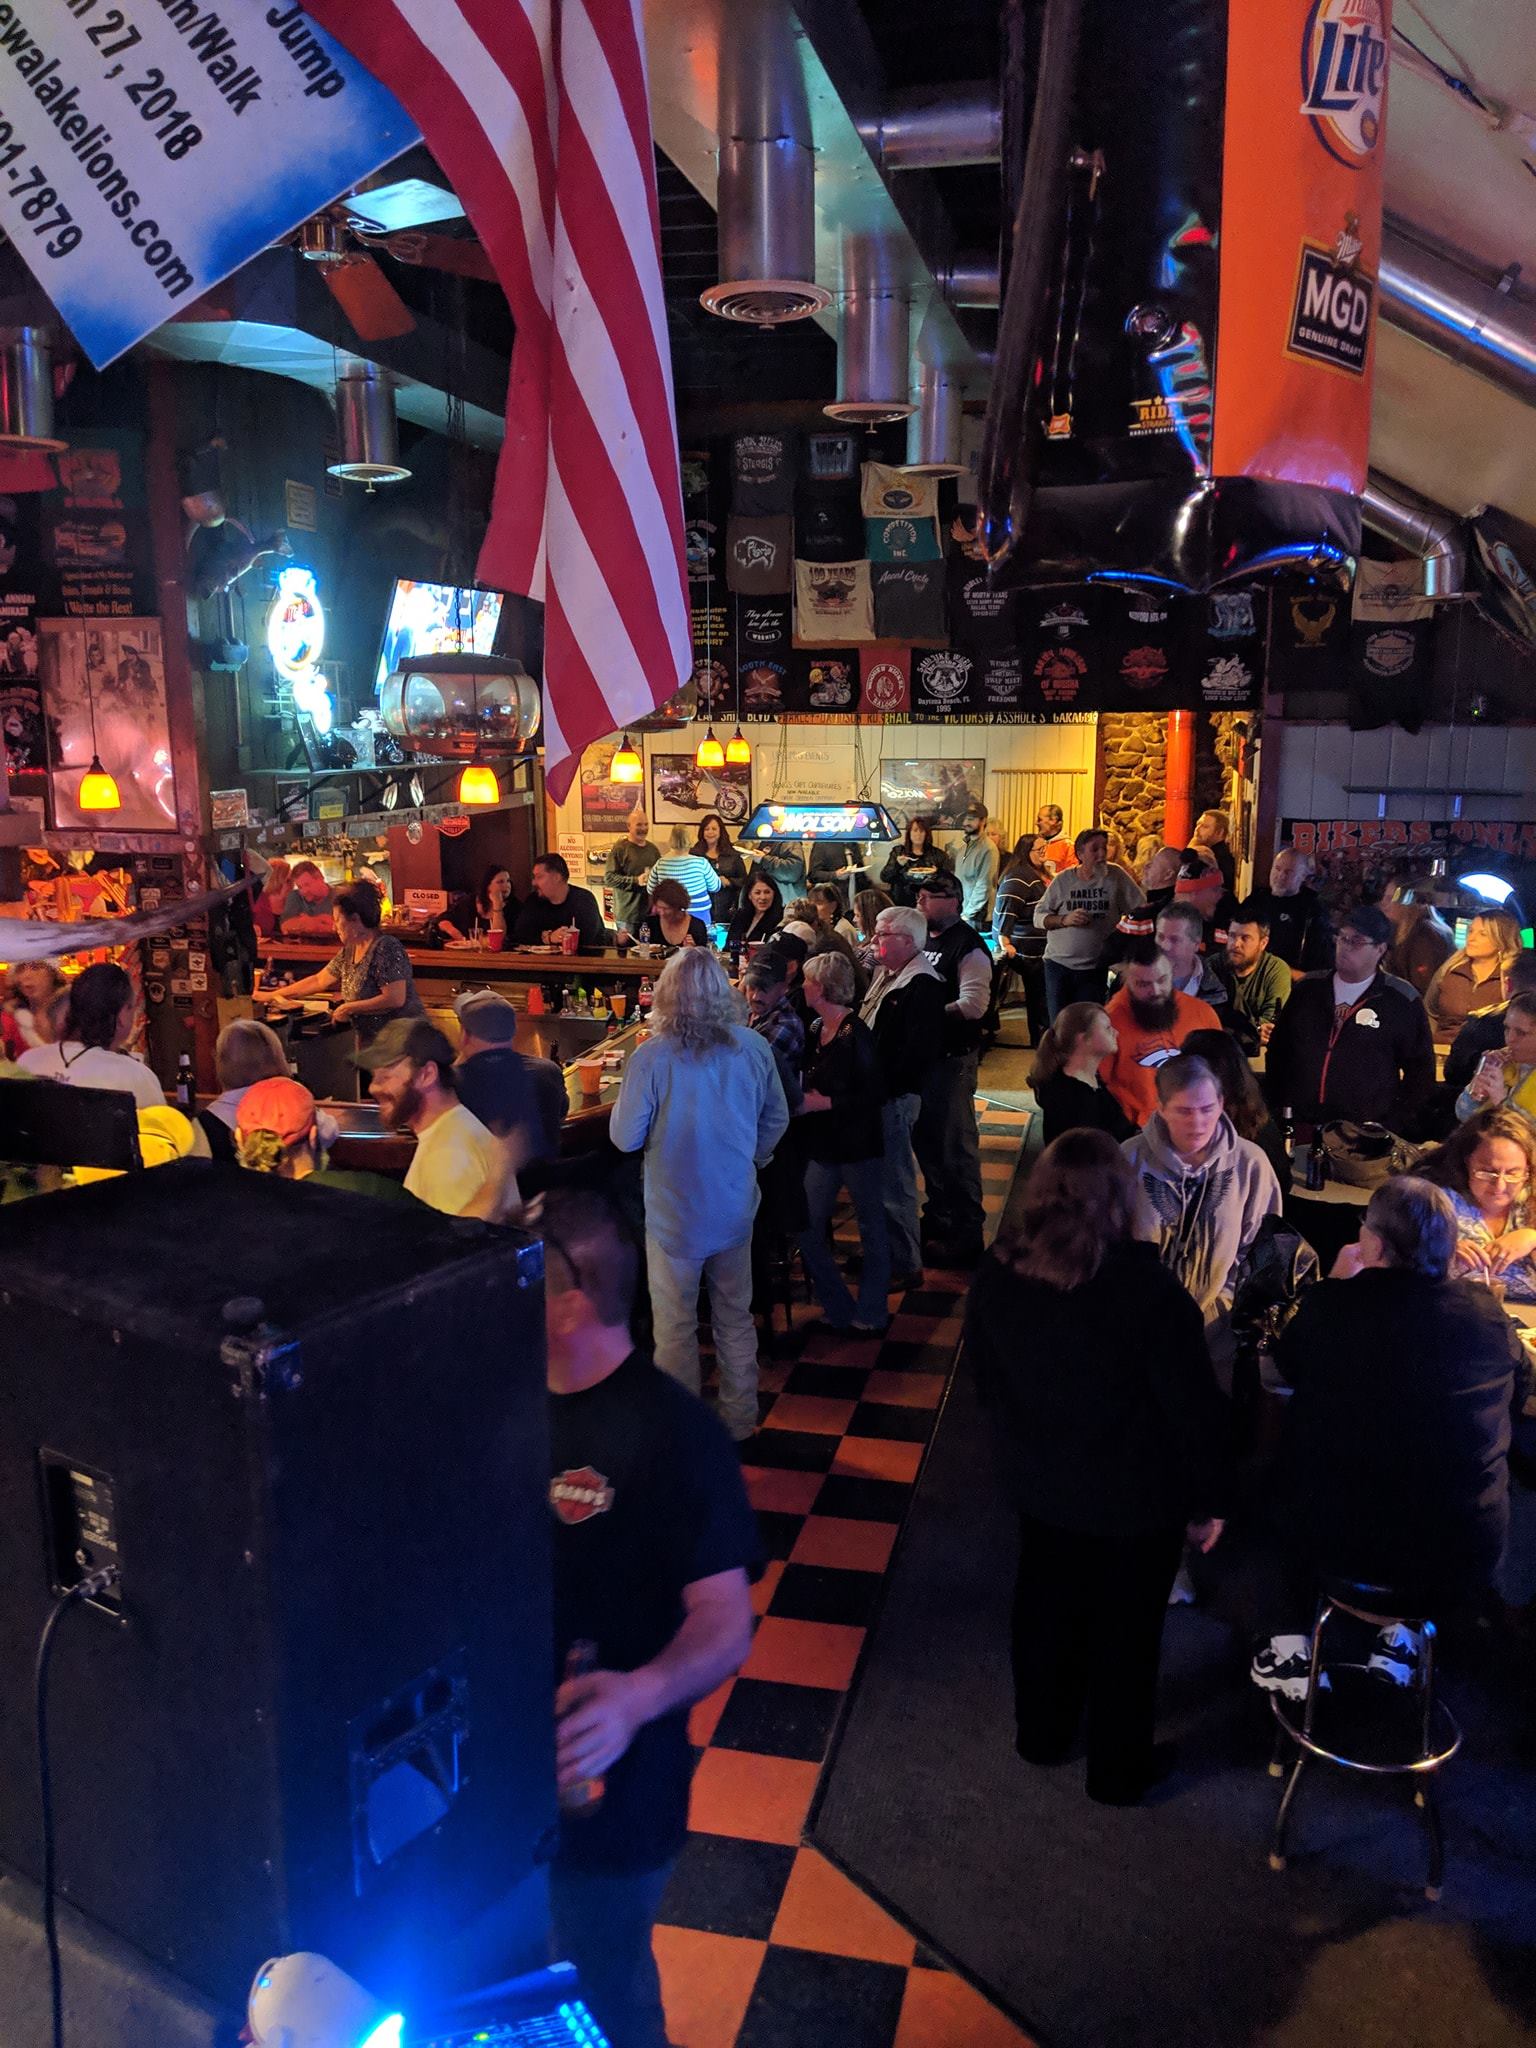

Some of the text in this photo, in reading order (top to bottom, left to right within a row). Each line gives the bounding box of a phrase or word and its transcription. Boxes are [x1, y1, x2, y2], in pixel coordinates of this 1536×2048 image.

[265, 0, 346, 100] Jump
[1302, 21, 1386, 112] Lite
[124, 68, 203, 161] 2018
[0, 4, 195, 300] ewalakelions.com
[1303, 268, 1367, 335] MGD
[1299, 326, 1362, 359] GENUINE DRAFT
[889, 713, 911, 723] HAIL
[780, 813, 857, 832] MOLSON
[1292, 821, 1432, 854] BIKERS
[1066, 900, 1109, 911] DAVIDSON
[1070, 887, 1107, 899] HARLEY-
